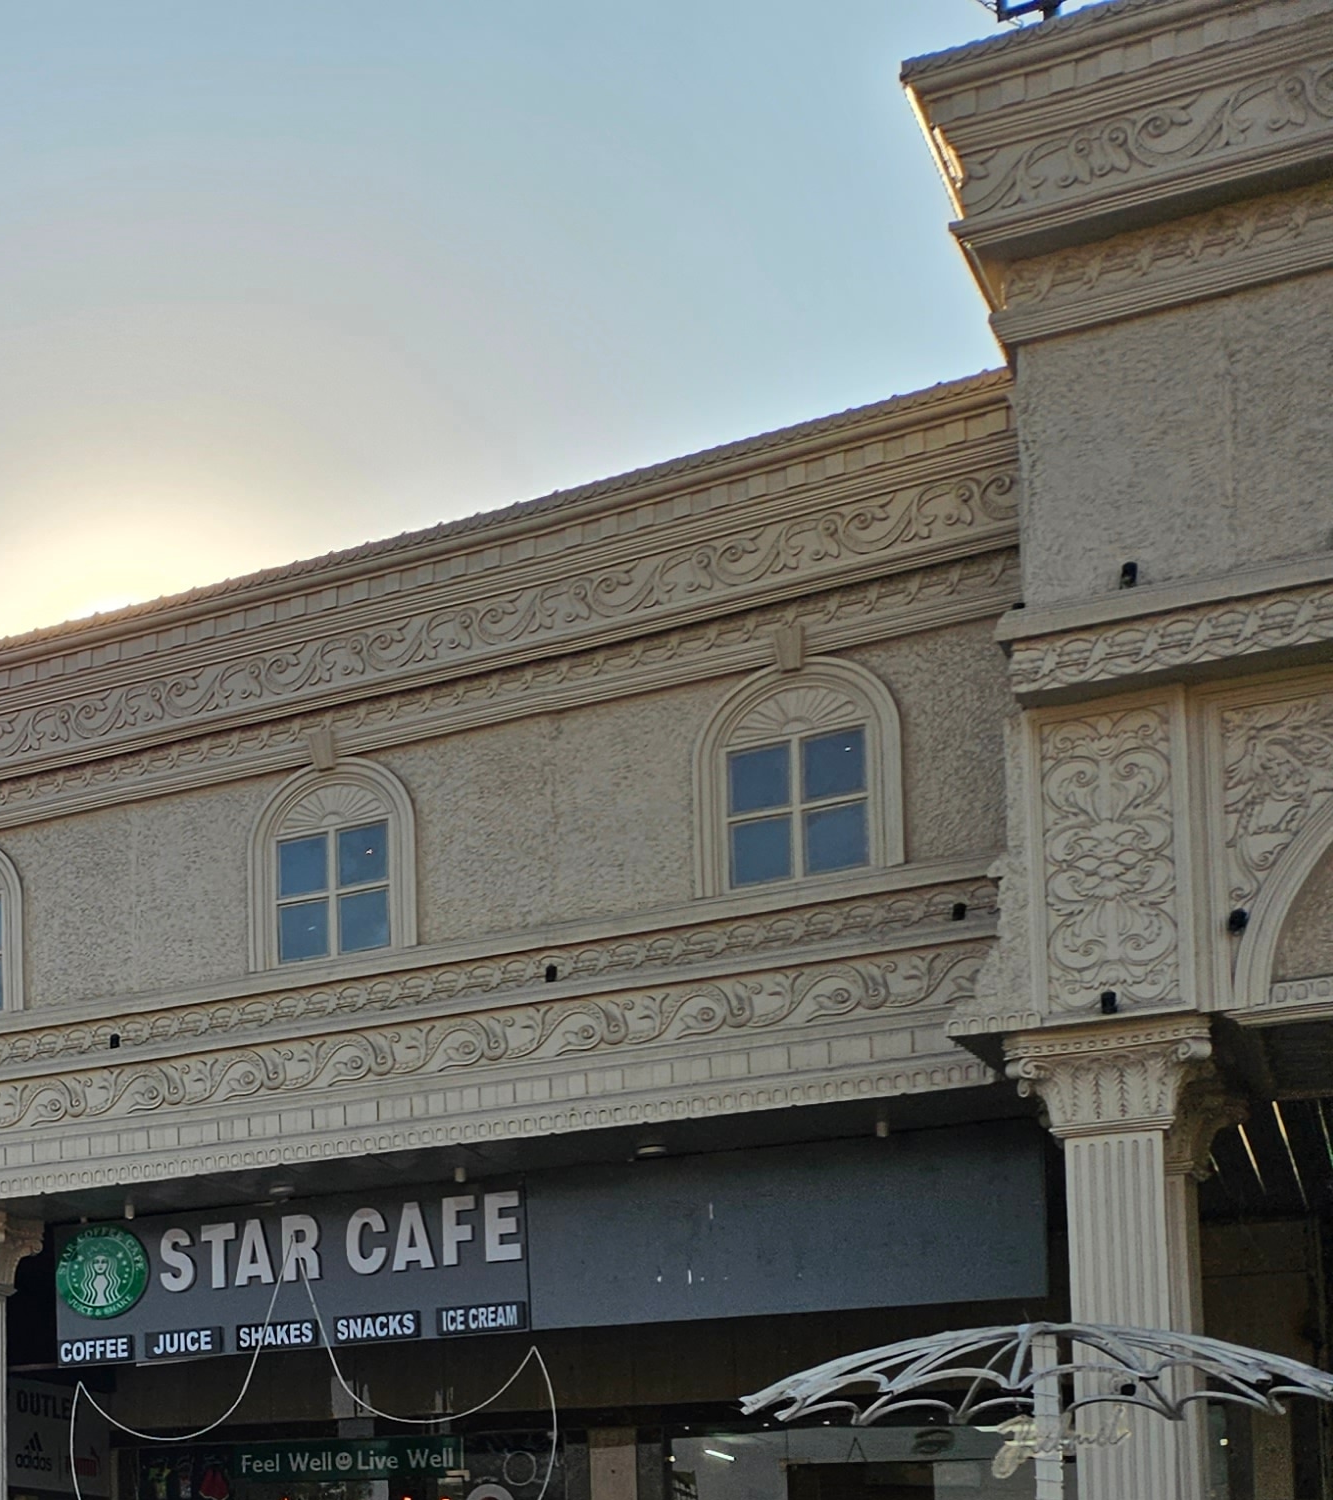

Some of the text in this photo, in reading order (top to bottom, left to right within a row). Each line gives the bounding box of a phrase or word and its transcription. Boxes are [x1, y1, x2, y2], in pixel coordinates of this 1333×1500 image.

[159, 1191, 524, 1292] STAR CAFE
[336, 1312, 416, 1342] SNACKS
[442, 1304, 518, 1332] ICE CREAM
[153, 1329, 213, 1356] JUICE
[238, 1320, 313, 1349] SHAKES
[60, 1338, 128, 1363] COFFEE
[241, 1448, 454, 1473] Feel Well Live Well
